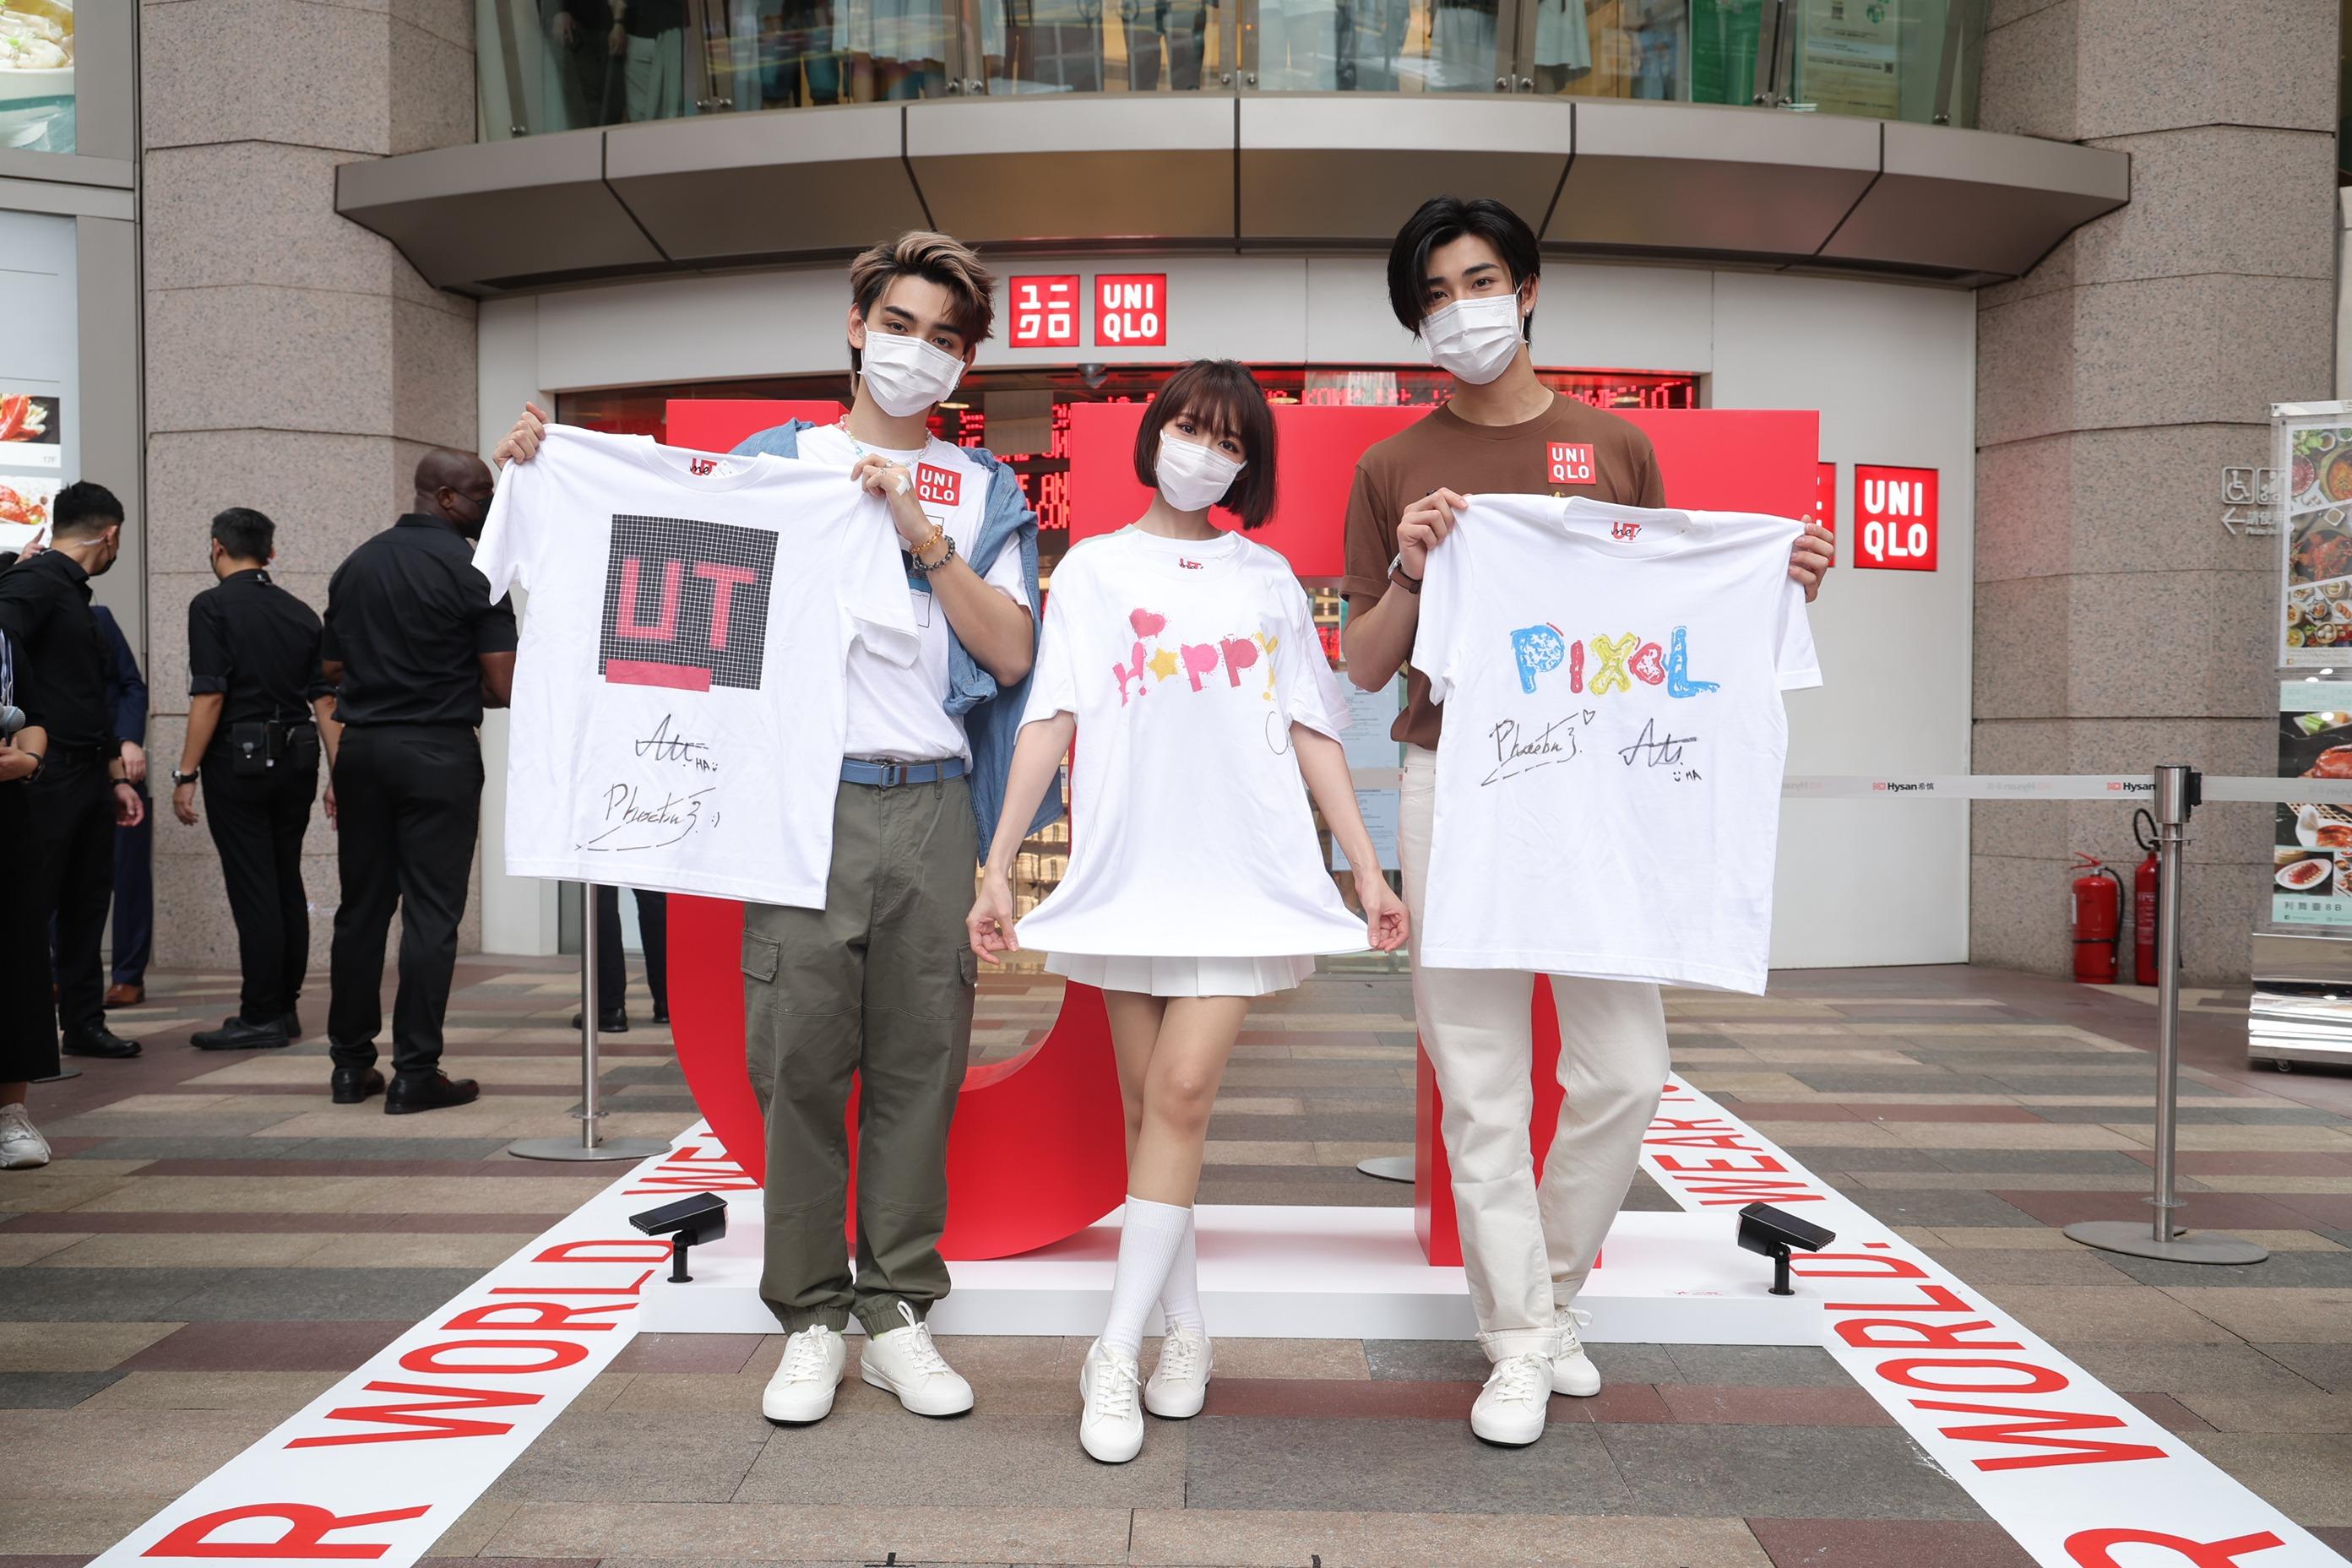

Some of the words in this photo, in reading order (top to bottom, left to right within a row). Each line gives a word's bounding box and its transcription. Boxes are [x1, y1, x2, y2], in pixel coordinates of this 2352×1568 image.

[1103, 284, 1154, 309] UNI
[1103, 313, 1158, 342] QLO
[1552, 447, 1585, 463] UNI
[921, 468, 953, 488] UNI
[1553, 464, 1589, 481] QLO
[919, 485, 955, 502] QLO
[1864, 479, 1923, 517] UNI
[1864, 520, 1928, 562] QLO
[615, 556, 757, 651] UT
[1888, 782, 1917, 792] Hysan
[2123, 782, 2155, 792] Hysan
